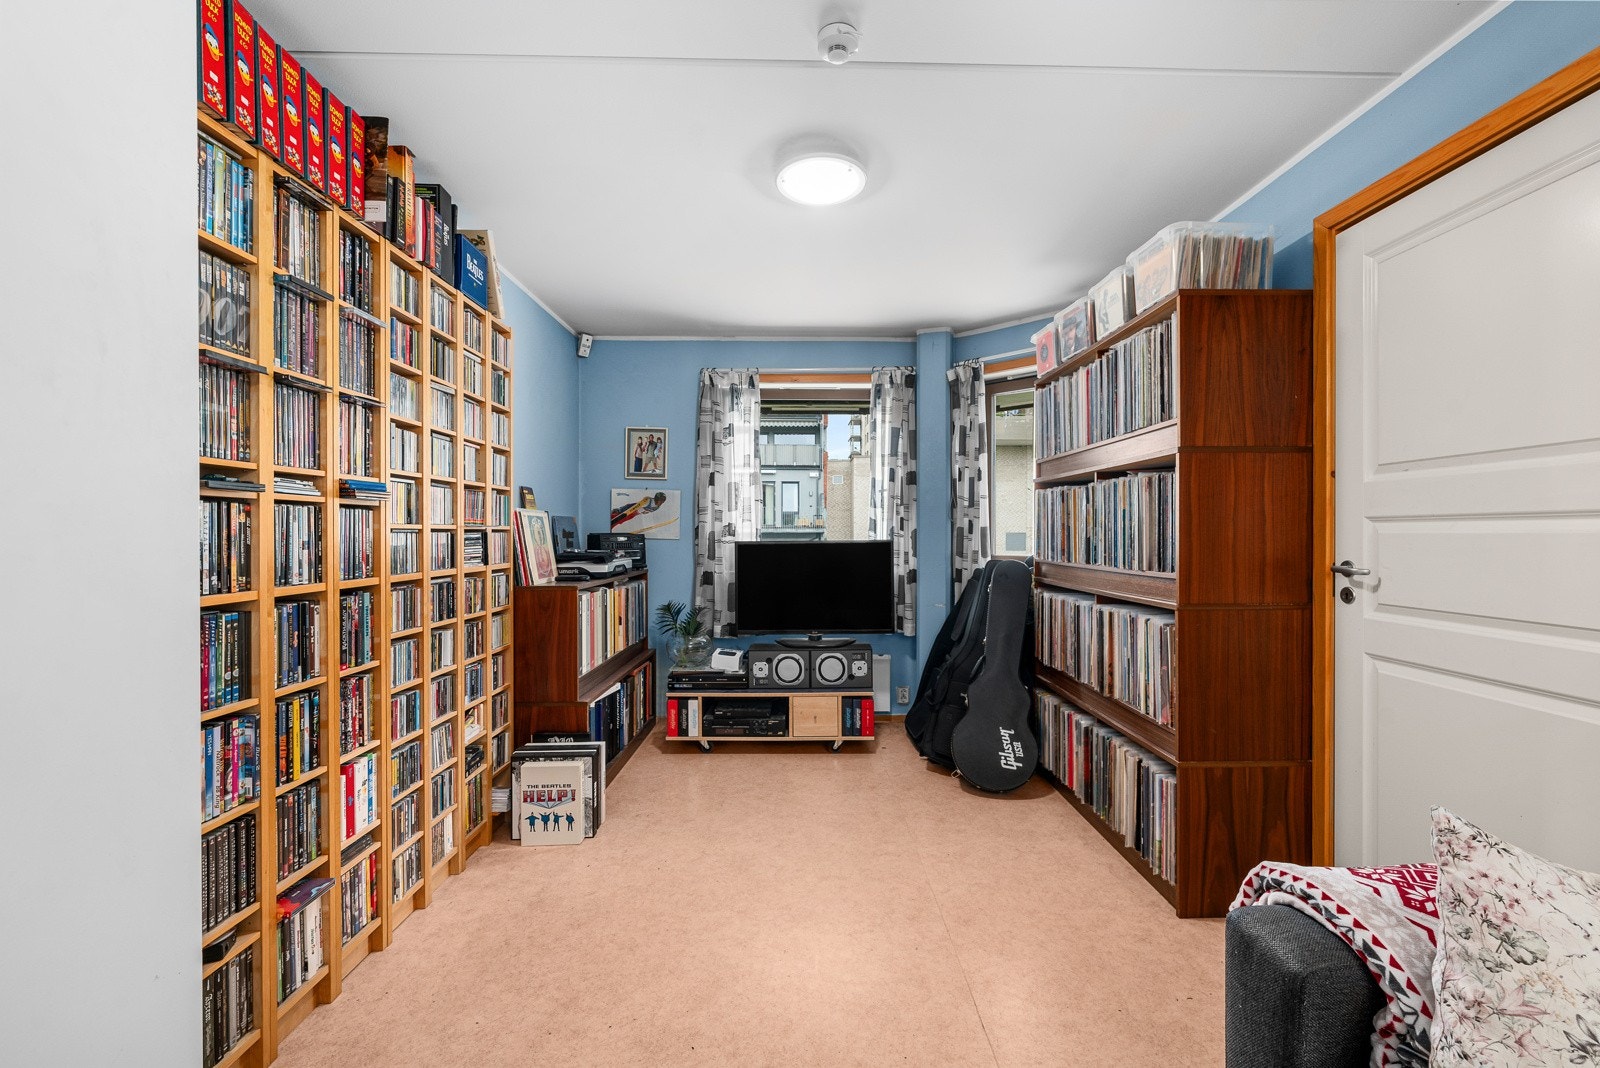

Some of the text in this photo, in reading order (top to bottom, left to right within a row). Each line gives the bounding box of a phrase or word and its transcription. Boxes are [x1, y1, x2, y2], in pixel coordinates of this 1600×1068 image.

[235, 13, 252, 35] DONALD
[237, 25, 250, 43] DUCK
[259, 38, 275, 59] DONALD
[262, 52, 273, 66] DUCK
[282, 60, 299, 80] DONALD
[285, 74, 297, 88] DUCK
[306, 83, 321, 103] DONALD
[309, 95, 319, 109] DUCK
[330, 104, 343, 122] DONALD
[332, 114, 342, 128] DUCK
[352, 122, 363, 138] DONALD
[354, 132, 362, 144] DUCK
[466, 254, 484, 281] BEATLES
[999, 726, 1023, 770] Gibson
[1013, 742, 1024, 757] USA
[522, 789, 576, 802] HELP!
